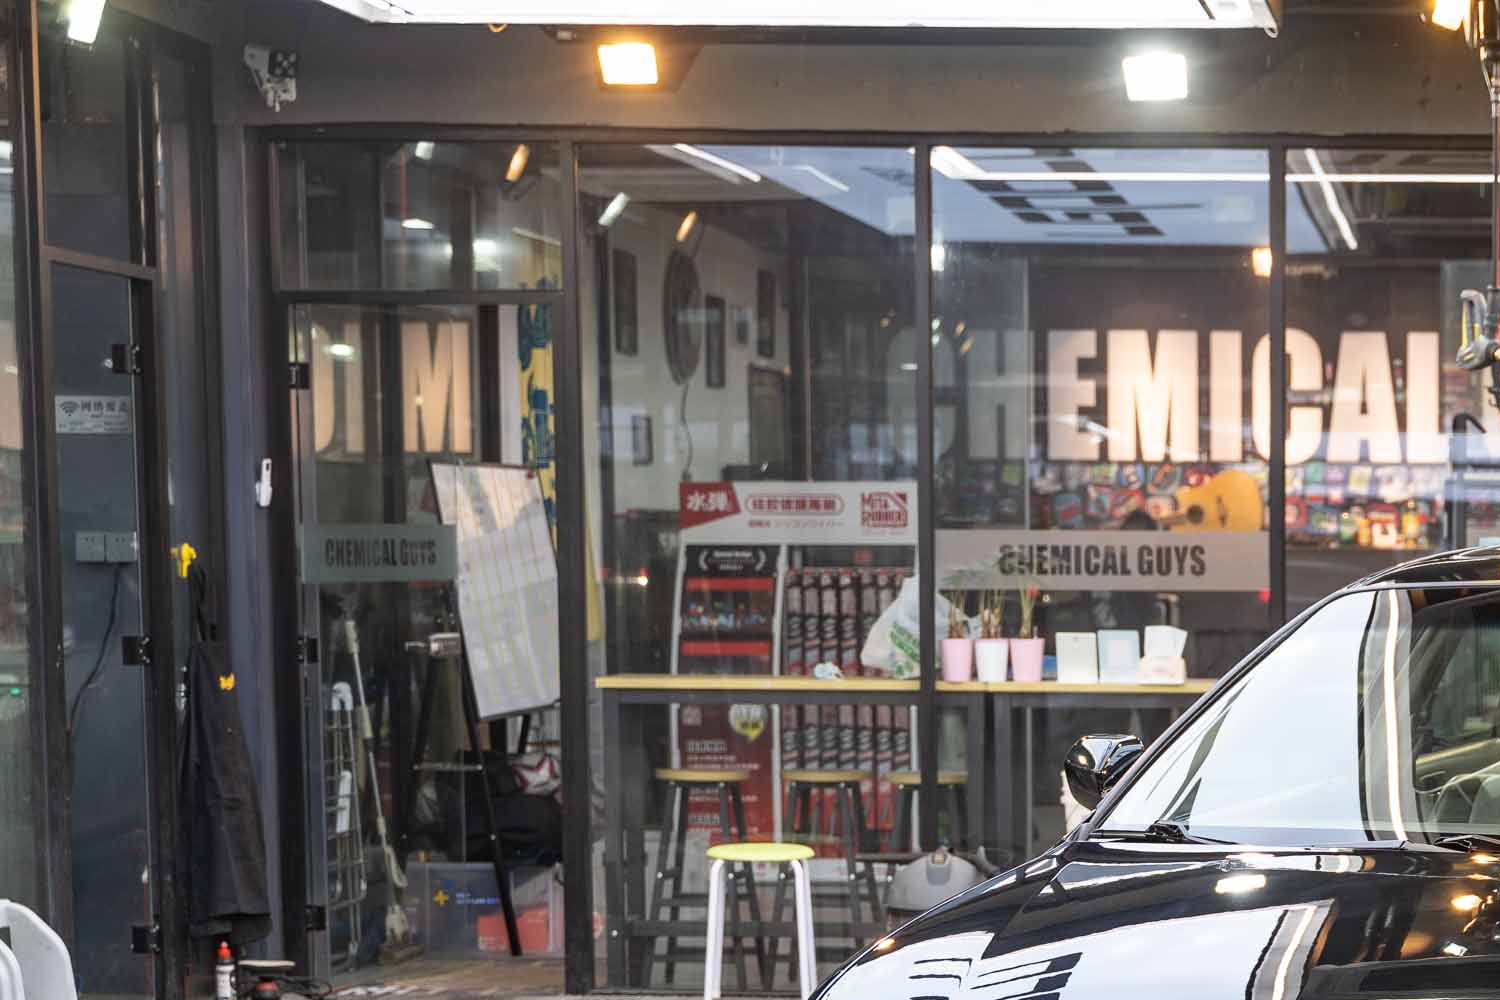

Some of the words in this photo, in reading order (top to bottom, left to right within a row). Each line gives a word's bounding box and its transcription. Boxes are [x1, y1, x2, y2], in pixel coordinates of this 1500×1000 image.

[325, 538, 397, 567] CHEMICAL
[400, 538, 437, 566] GUYS
[999, 545, 1131, 576] CHEMICAL
[1138, 545, 1206, 576] GUYS
